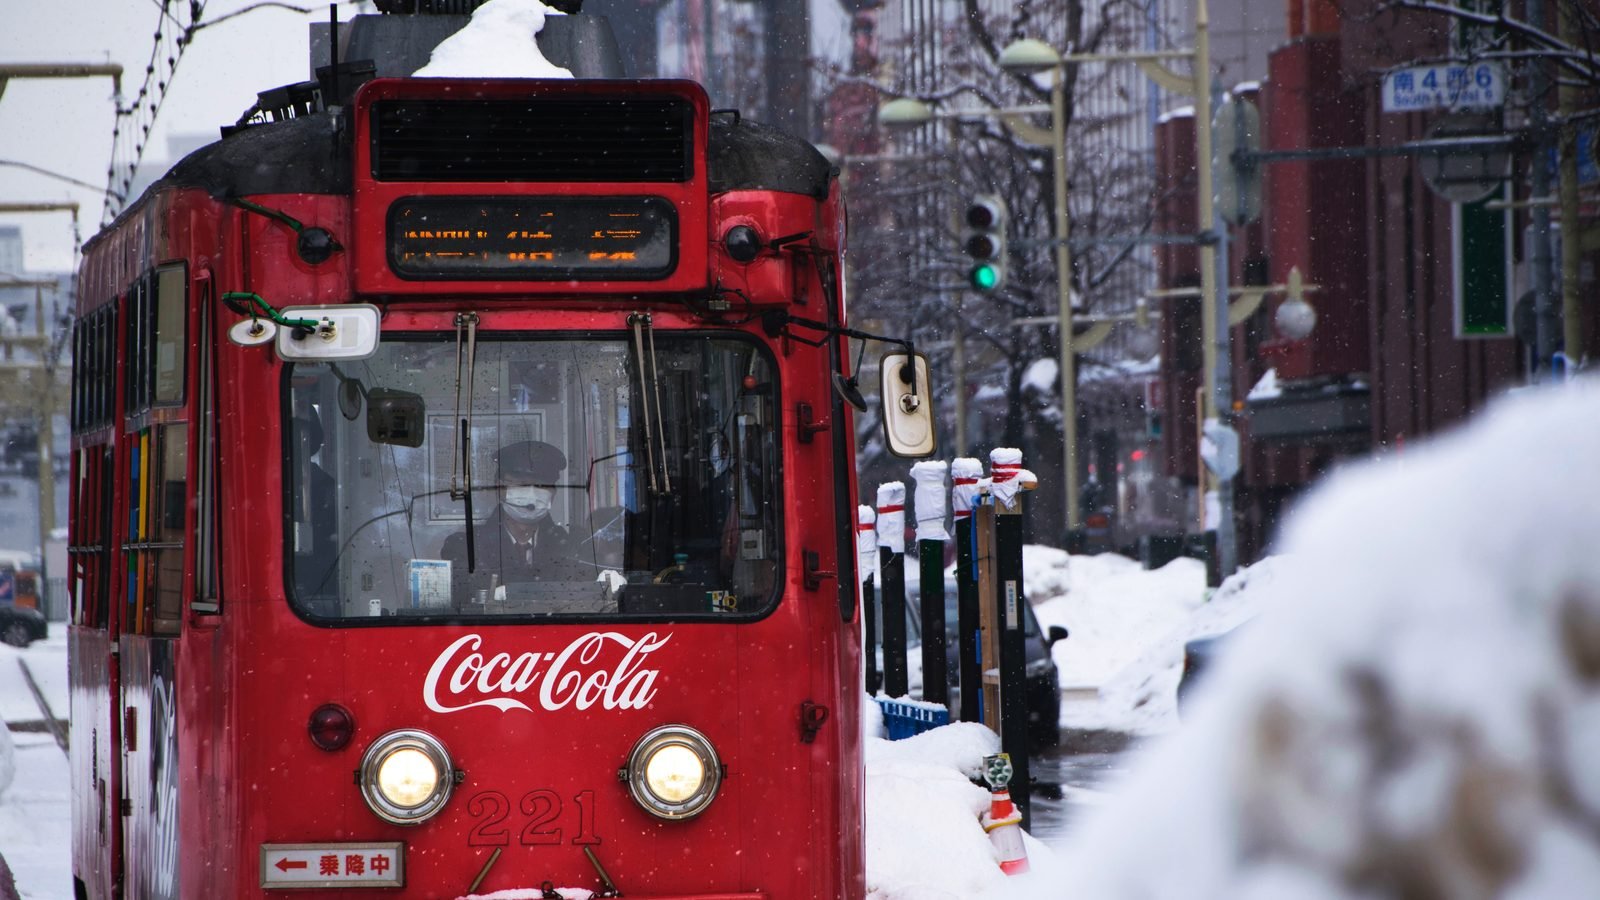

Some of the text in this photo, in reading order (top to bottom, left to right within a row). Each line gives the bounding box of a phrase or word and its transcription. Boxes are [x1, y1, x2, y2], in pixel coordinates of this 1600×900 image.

[423, 632, 673, 713] Coca-Cola
[468, 789, 602, 847] 221
[319, 854, 390, 876] 乗降中
